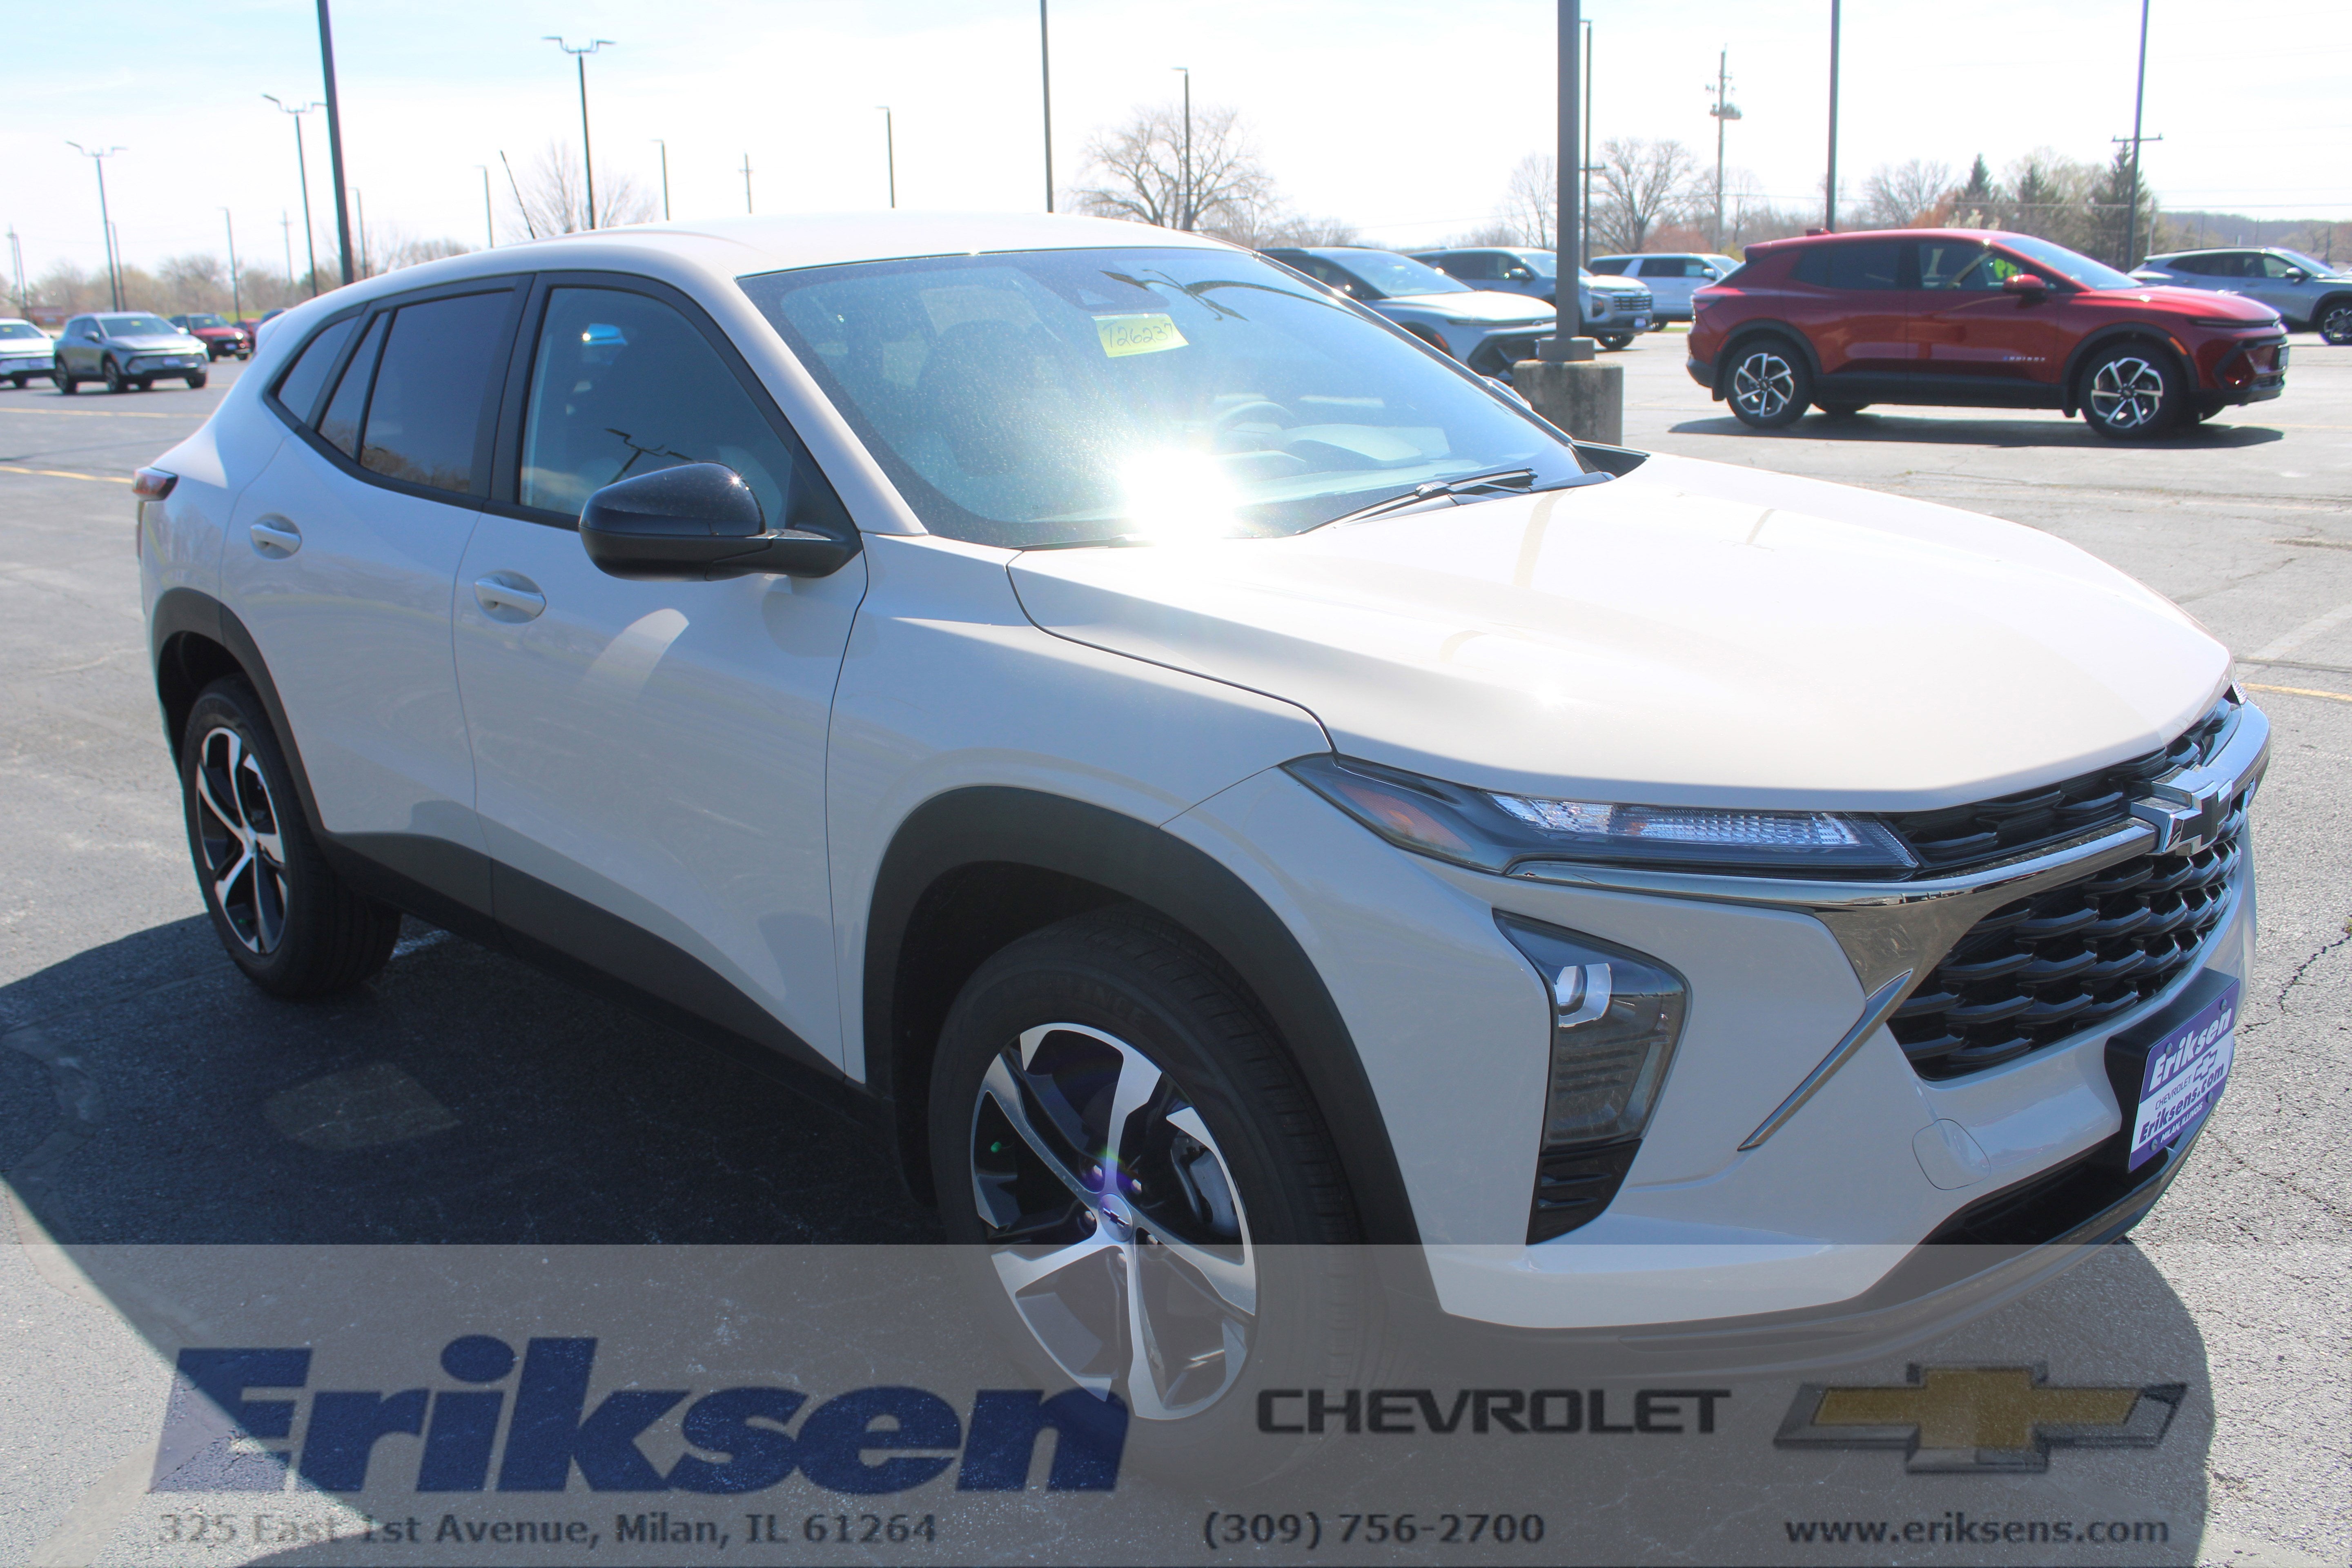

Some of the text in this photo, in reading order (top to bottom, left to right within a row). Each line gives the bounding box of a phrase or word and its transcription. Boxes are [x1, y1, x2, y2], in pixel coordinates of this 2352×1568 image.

[2149, 1008, 2232, 1092] Eriksen
[2139, 1063, 2224, 1144] Eriksens.com
[2155, 1074, 2192, 1110] CHEVROLET
[2160, 1101, 2203, 1143] MILAN, ILLINOIS
